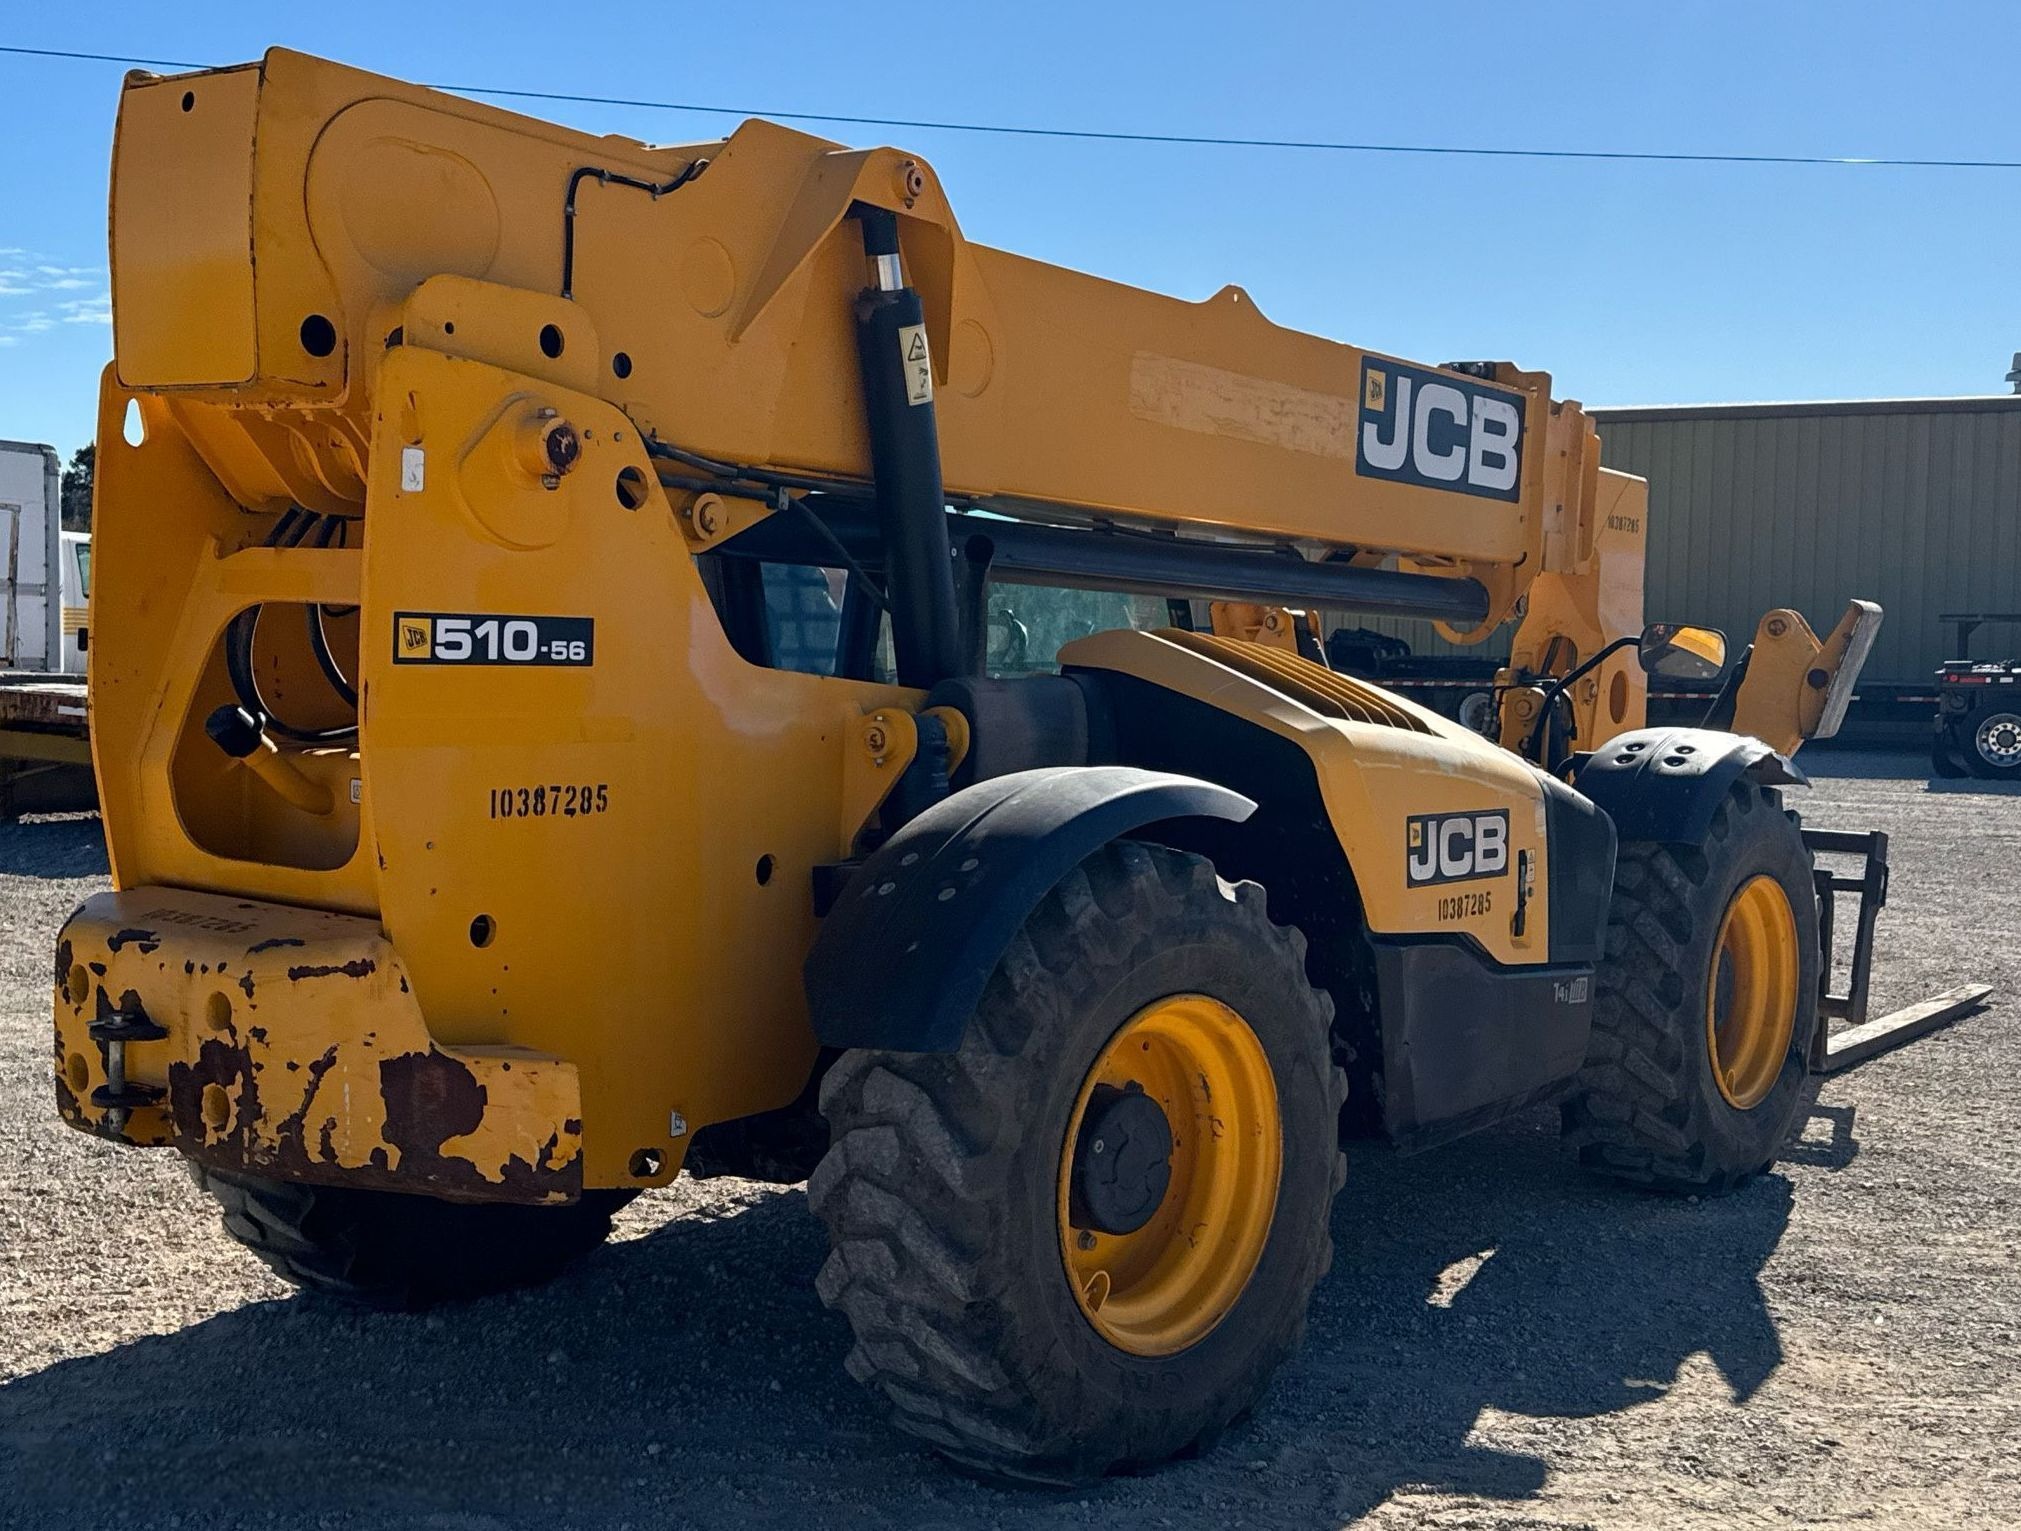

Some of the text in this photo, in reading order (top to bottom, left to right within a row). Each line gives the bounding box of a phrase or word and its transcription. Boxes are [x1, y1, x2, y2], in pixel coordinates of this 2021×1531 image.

[1363, 376, 1519, 491] JCB
[406, 619, 586, 661] JCB 510-56
[490, 784, 608, 818] 10387285
[1409, 815, 1507, 881] JCB
[1438, 891, 1492, 921] 10387285
